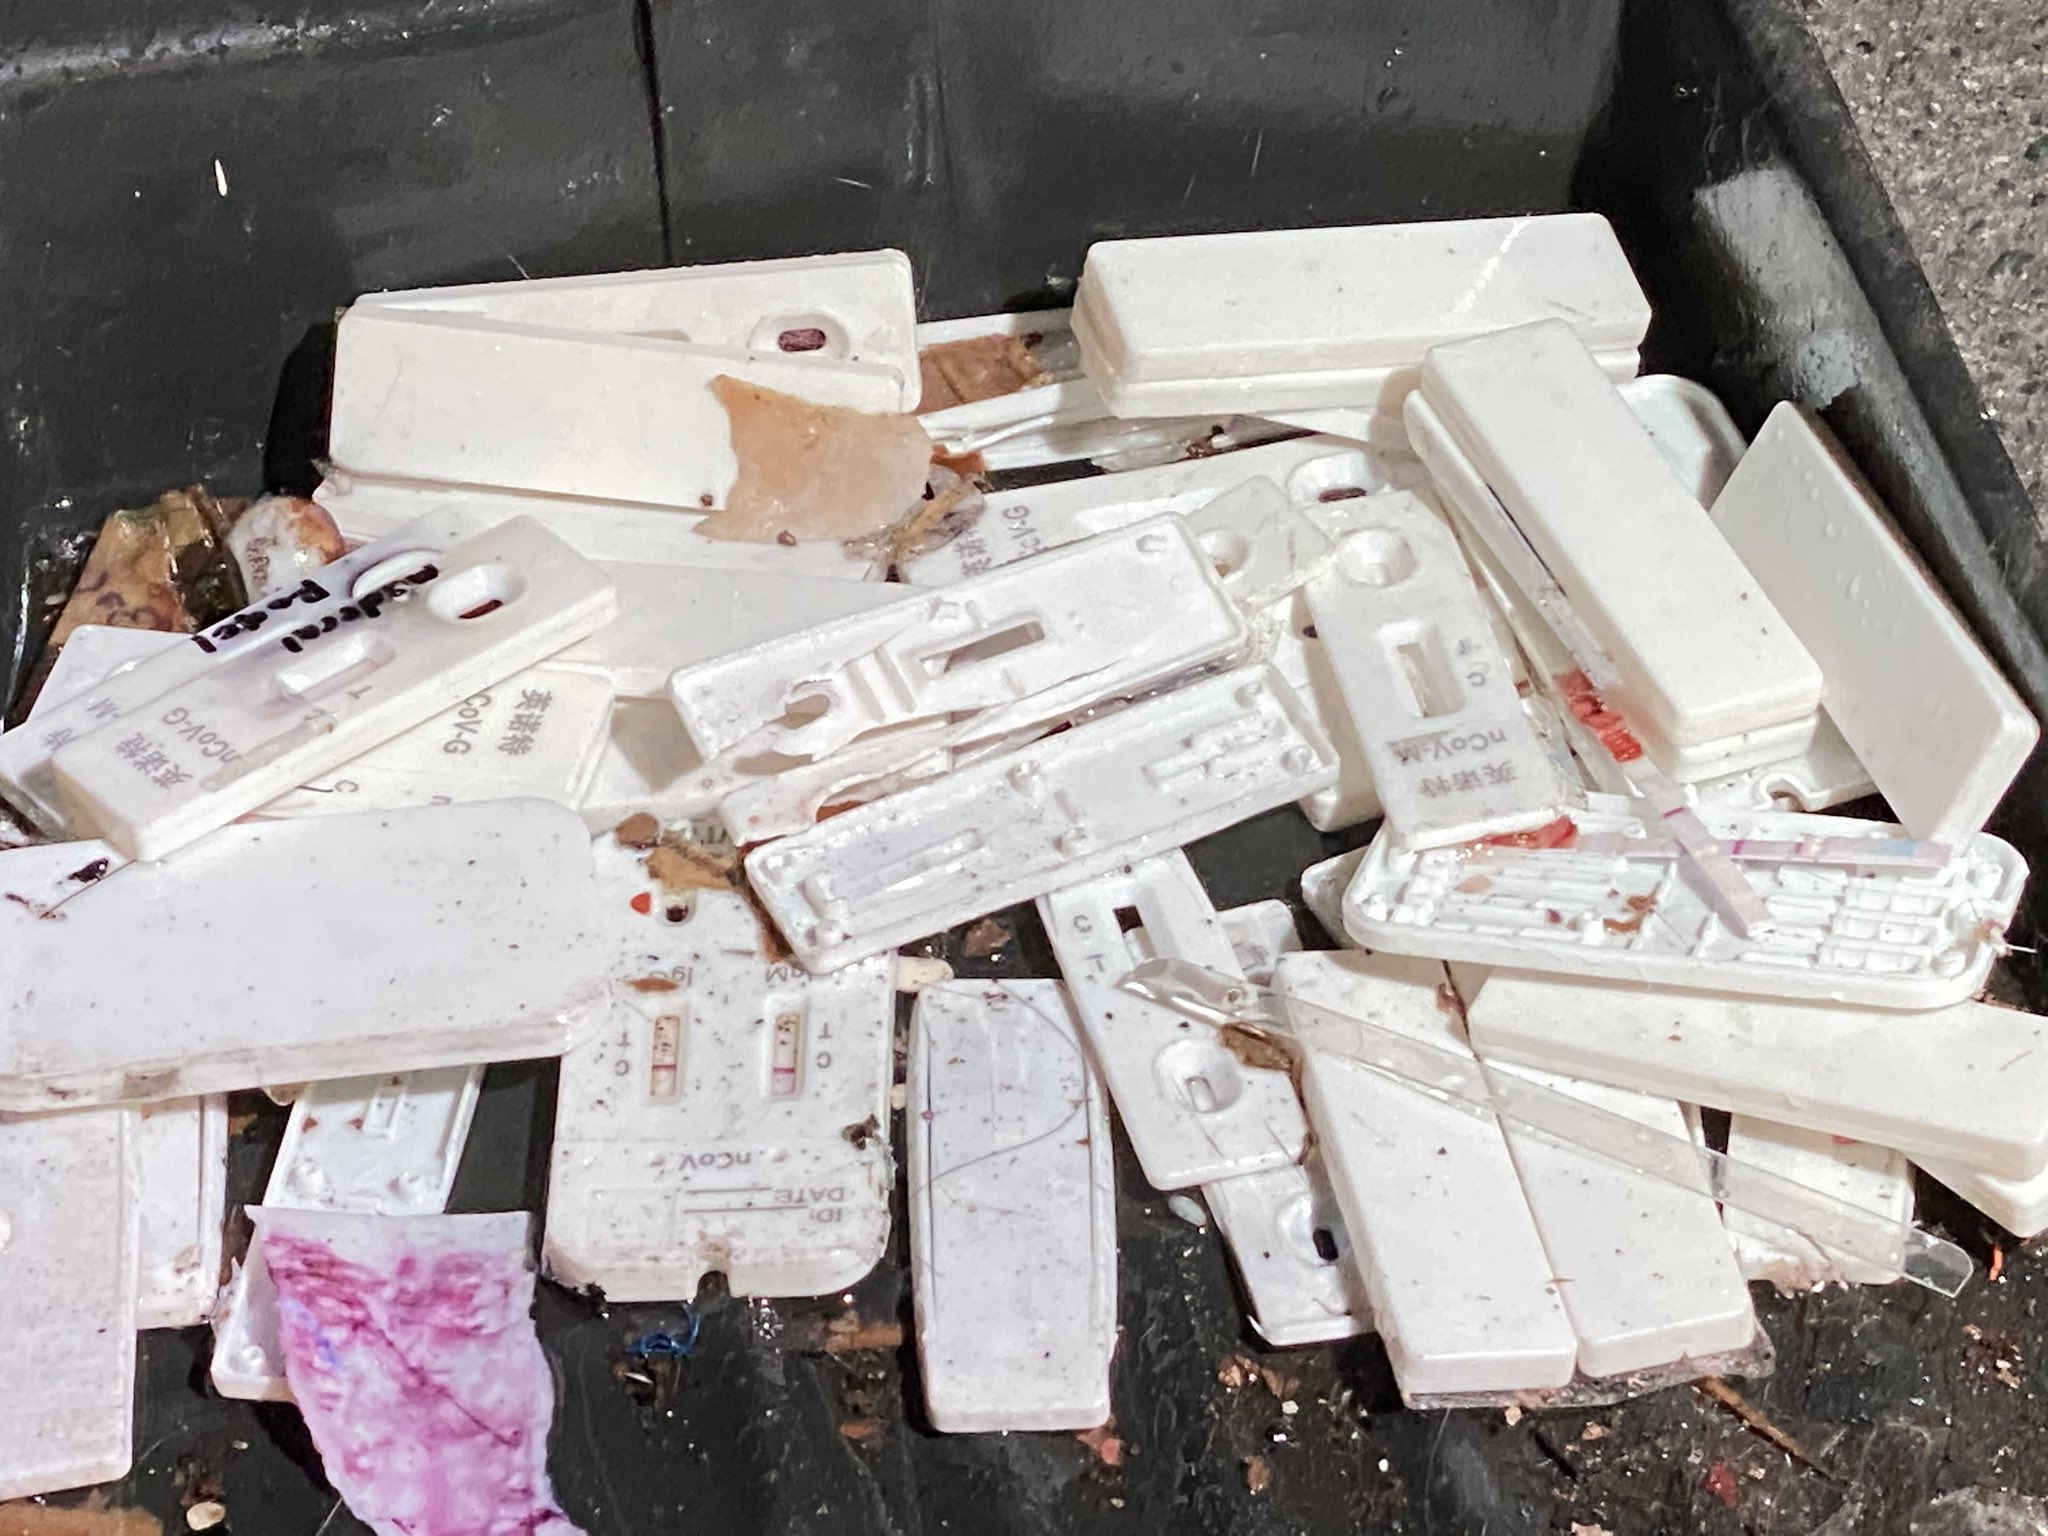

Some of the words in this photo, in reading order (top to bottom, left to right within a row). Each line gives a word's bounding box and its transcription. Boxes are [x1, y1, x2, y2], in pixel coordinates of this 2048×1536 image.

[1466, 672, 1486, 688] C
[497, 689, 554, 756] 英诺特
[162, 707, 241, 764] nCoV-G
[115, 732, 193, 790] 英诺特
[334, 779, 360, 793] C
[1419, 760, 1518, 800] 英诺特
[1073, 913, 1093, 934] C
[1086, 952, 1105, 973] T
[616, 1031, 631, 1048] T
[818, 1022, 833, 1040] T
[614, 1059, 630, 1077] C
[816, 1052, 832, 1070] C
[677, 1151, 752, 1171] nCoV
[773, 1186, 846, 1205] DATE:
[809, 1207, 844, 1223] ID:
